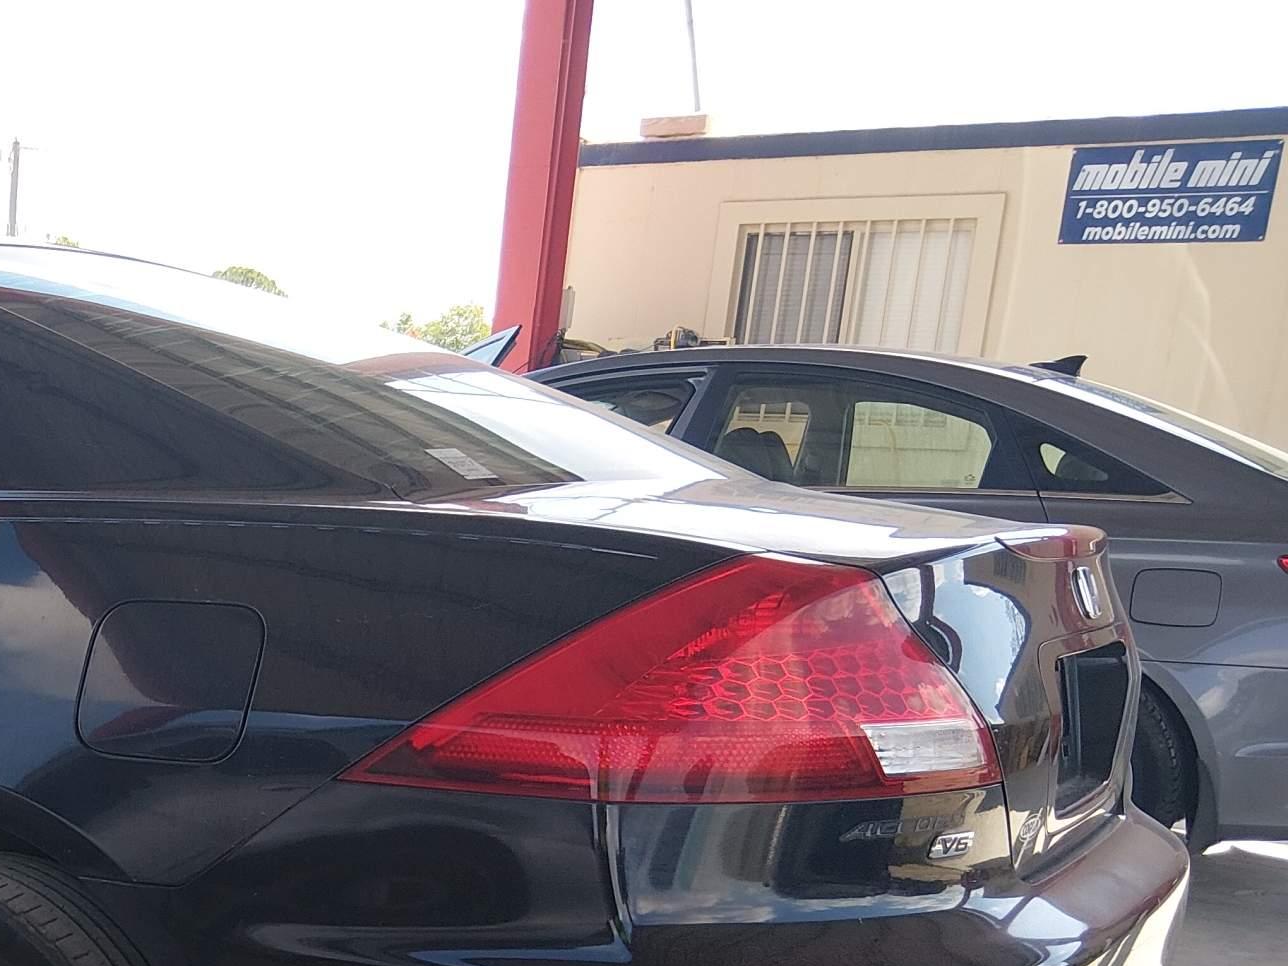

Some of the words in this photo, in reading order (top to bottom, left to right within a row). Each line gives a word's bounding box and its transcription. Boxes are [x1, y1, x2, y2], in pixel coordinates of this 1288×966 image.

[1072, 149, 1188, 190] mobile
[1187, 150, 1274, 187] mini
[1076, 196, 1256, 219] 1-800-950-6464
[1082, 221, 1241, 240] mobilemini.com
